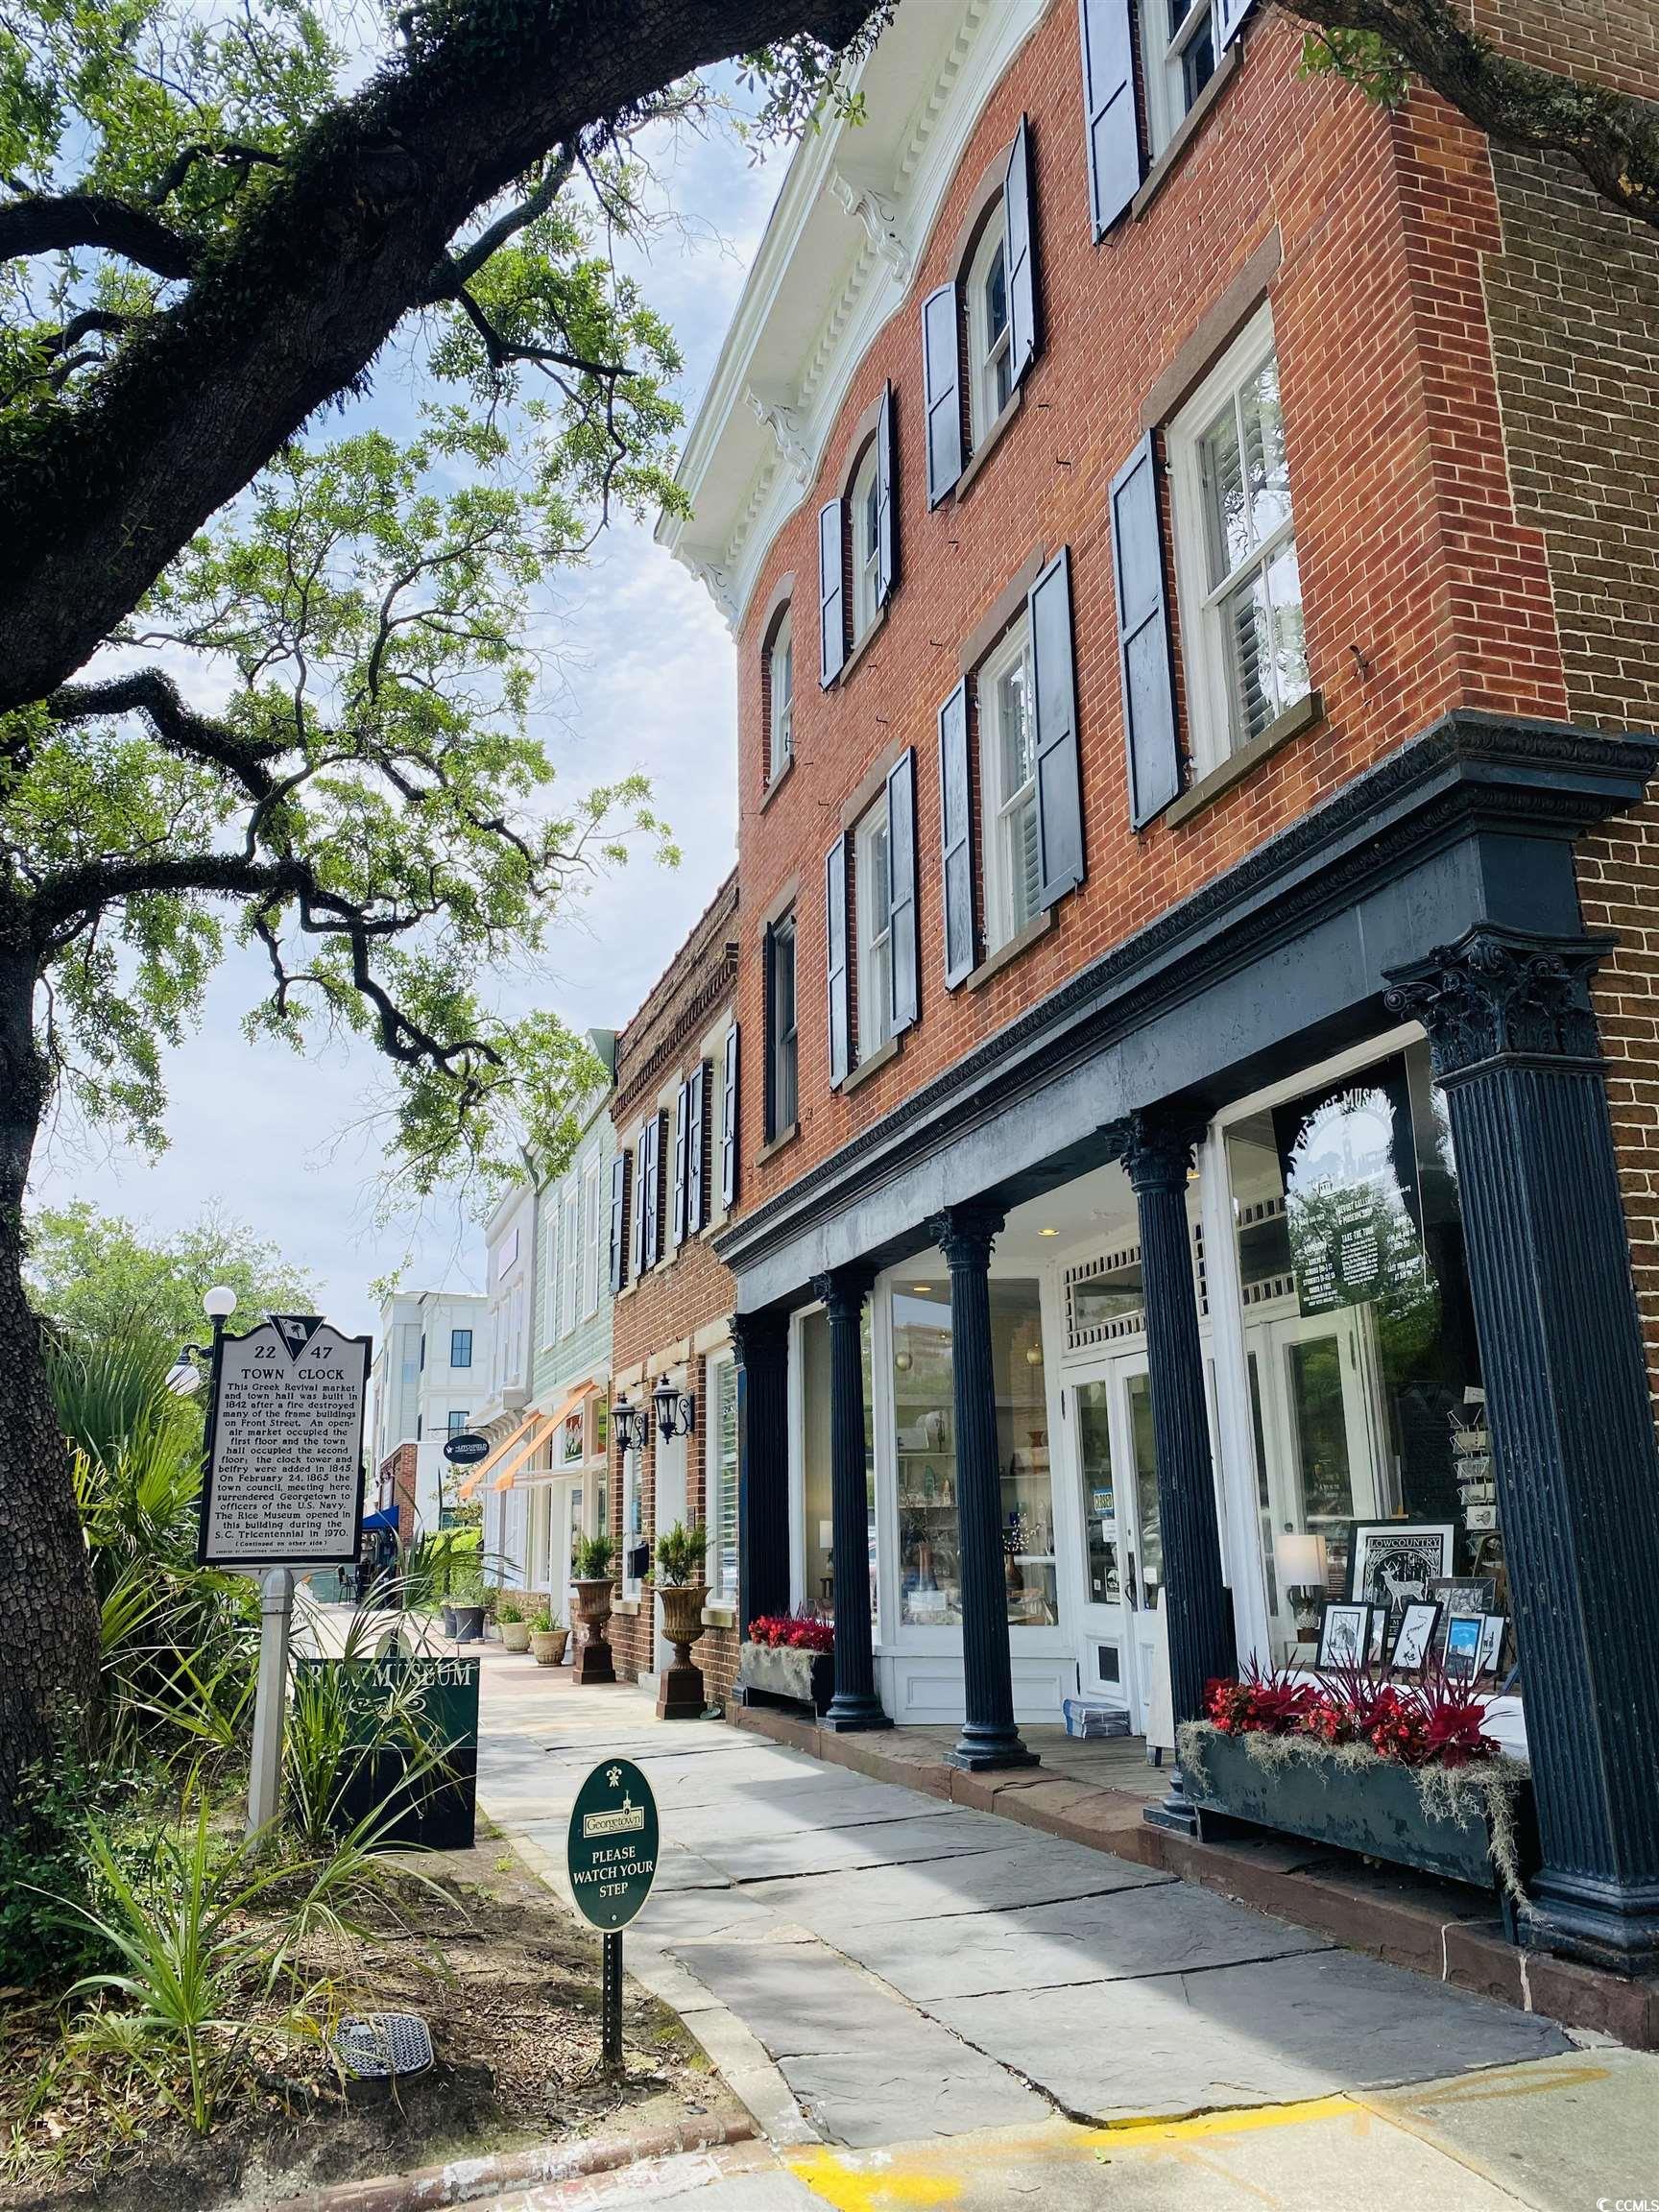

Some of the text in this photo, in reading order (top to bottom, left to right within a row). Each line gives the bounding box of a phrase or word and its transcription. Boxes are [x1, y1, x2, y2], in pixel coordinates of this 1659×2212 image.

[254, 1346, 333, 1358] 22 47
[241, 1369, 344, 1380] TOWN CLOCK
[317, 1410, 355, 1419] buildings
[219, 1465, 248, 1474] belfry
[247, 1483, 283, 1492] council,
[288, 1483, 324, 1492] meeting
[279, 1493, 336, 1502] Georgetown
[320, 1503, 346, 1511] Navy.
[306, 1511, 338, 1520] opened
[246, 1521, 283, 1529] building
[290, 1521, 321, 1529] during
[1370, 1538, 1439, 1548] LOWCOUNTRY
[588, 1815, 639, 1831] Georgetown
[592, 1846, 636, 1863] PLEASE
[573, 1861, 653, 1885] WATCH YOUR
[599, 1882, 628, 1898] STEP
